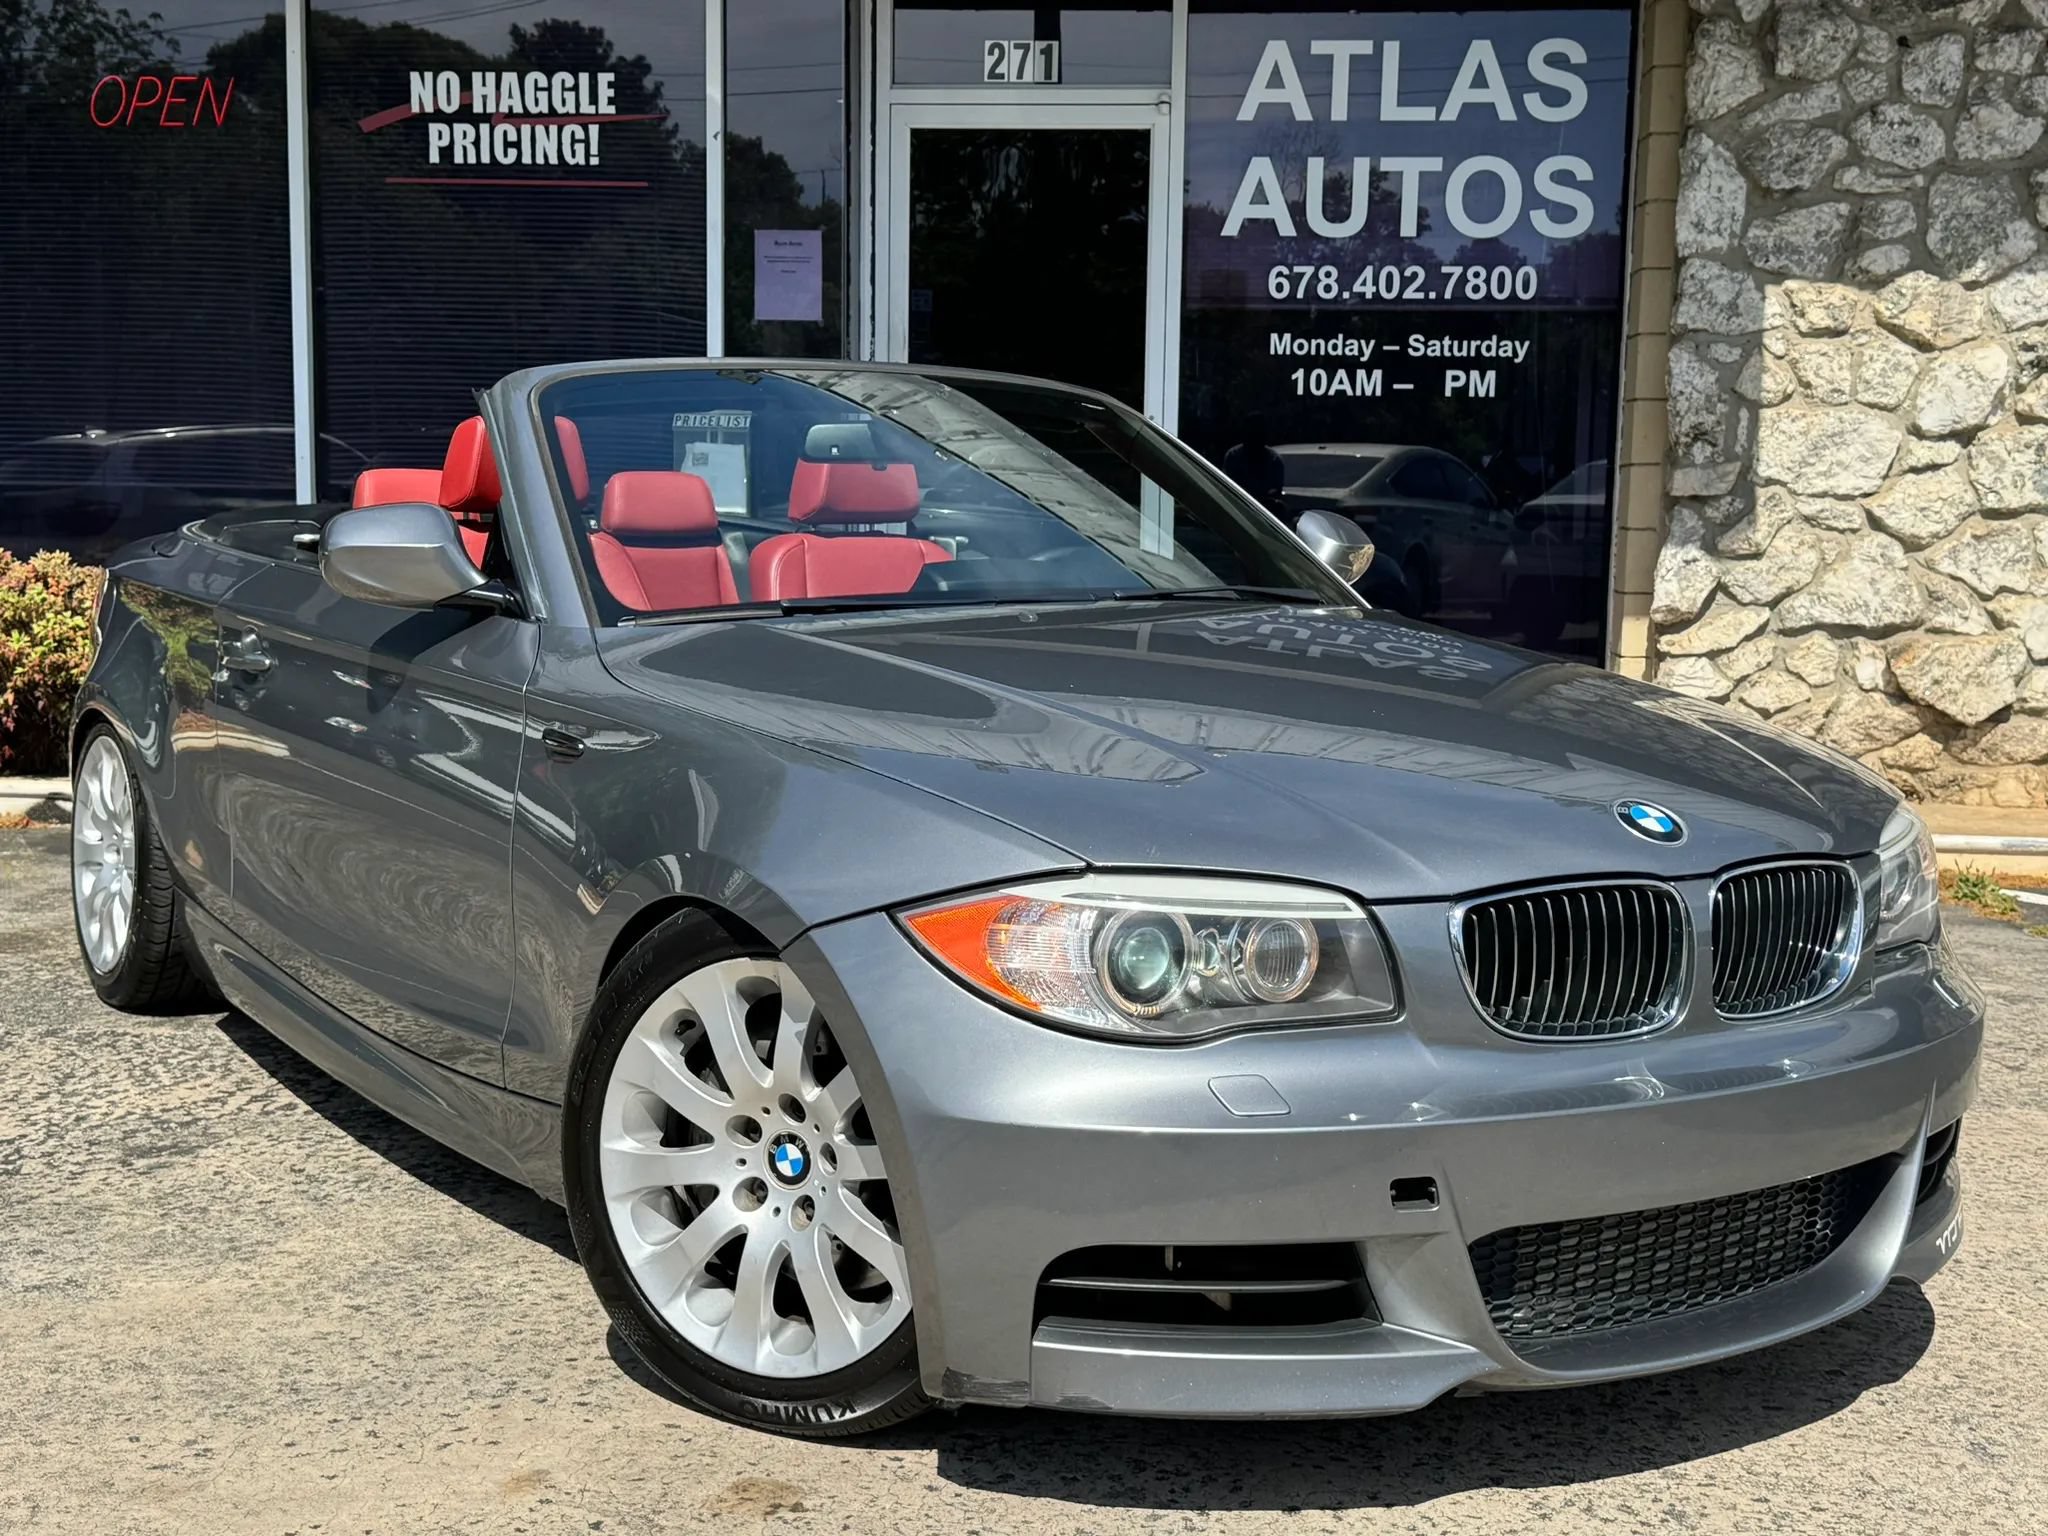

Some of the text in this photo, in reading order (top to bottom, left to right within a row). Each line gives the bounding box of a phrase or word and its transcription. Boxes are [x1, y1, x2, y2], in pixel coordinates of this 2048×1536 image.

[986, 41, 1057, 81] 271
[1236, 38, 1588, 122] ATLAS
[90, 75, 234, 128] OPEN
[410, 71, 616, 115] NO HAGGLE
[428, 123, 600, 166] PRICING!
[1221, 155, 1595, 239] AUTOS
[1268, 265, 1538, 300] 678.402.7800
[1269, 333, 1376, 363] Monday
[1408, 334, 1530, 364] Saturday
[1291, 368, 1383, 397] 10AM
[1444, 369, 1496, 398] PM
